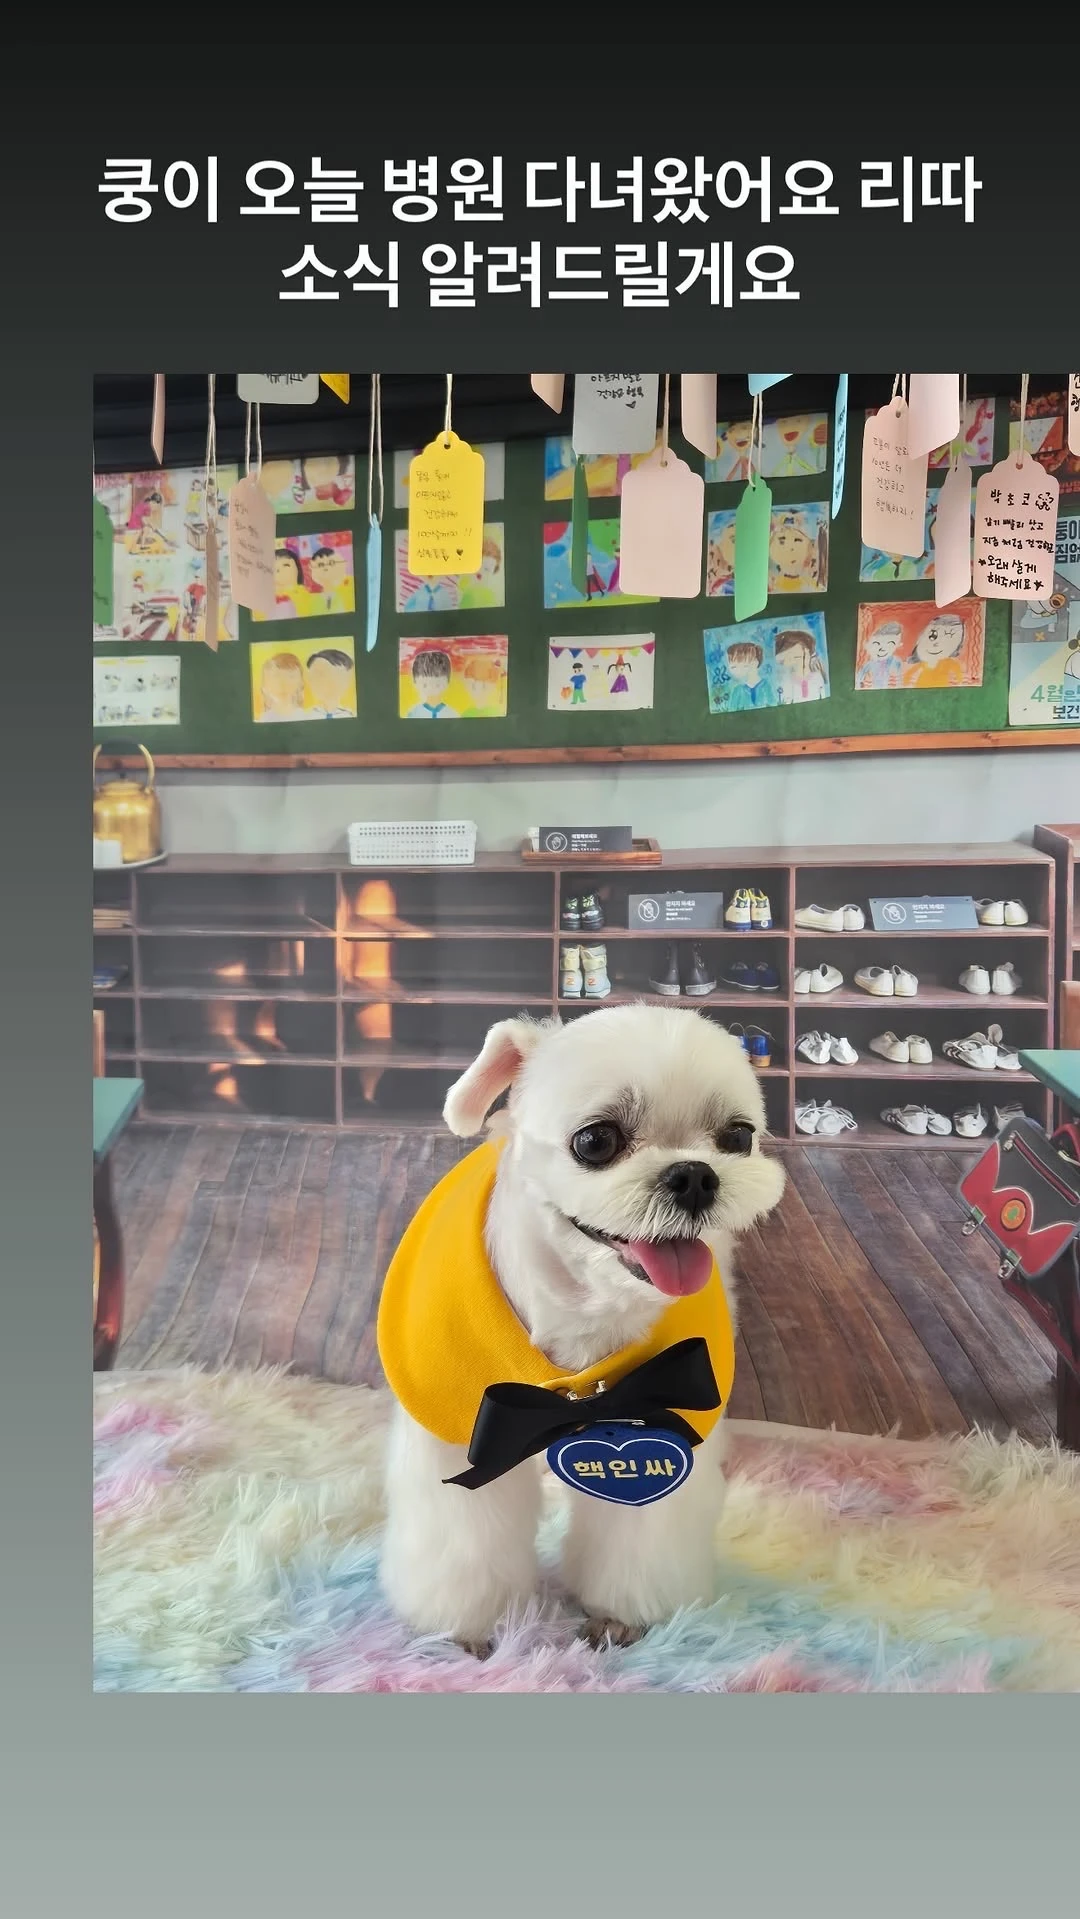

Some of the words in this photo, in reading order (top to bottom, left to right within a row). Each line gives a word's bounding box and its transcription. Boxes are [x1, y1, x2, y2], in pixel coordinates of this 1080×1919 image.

[990, 488, 1002, 504] 박
[984, 517, 1000, 527] 감기
[1002, 518, 1025, 531] 빨리
[982, 536, 999, 547] 지금
[1001, 538, 1023, 550] 처럼
[987, 554, 1009, 570] 오래
[1011, 559, 1037, 575] 살게
[986, 572, 1032, 590] 해주세요
[572, 1459, 677, 1479] 핵인싸
